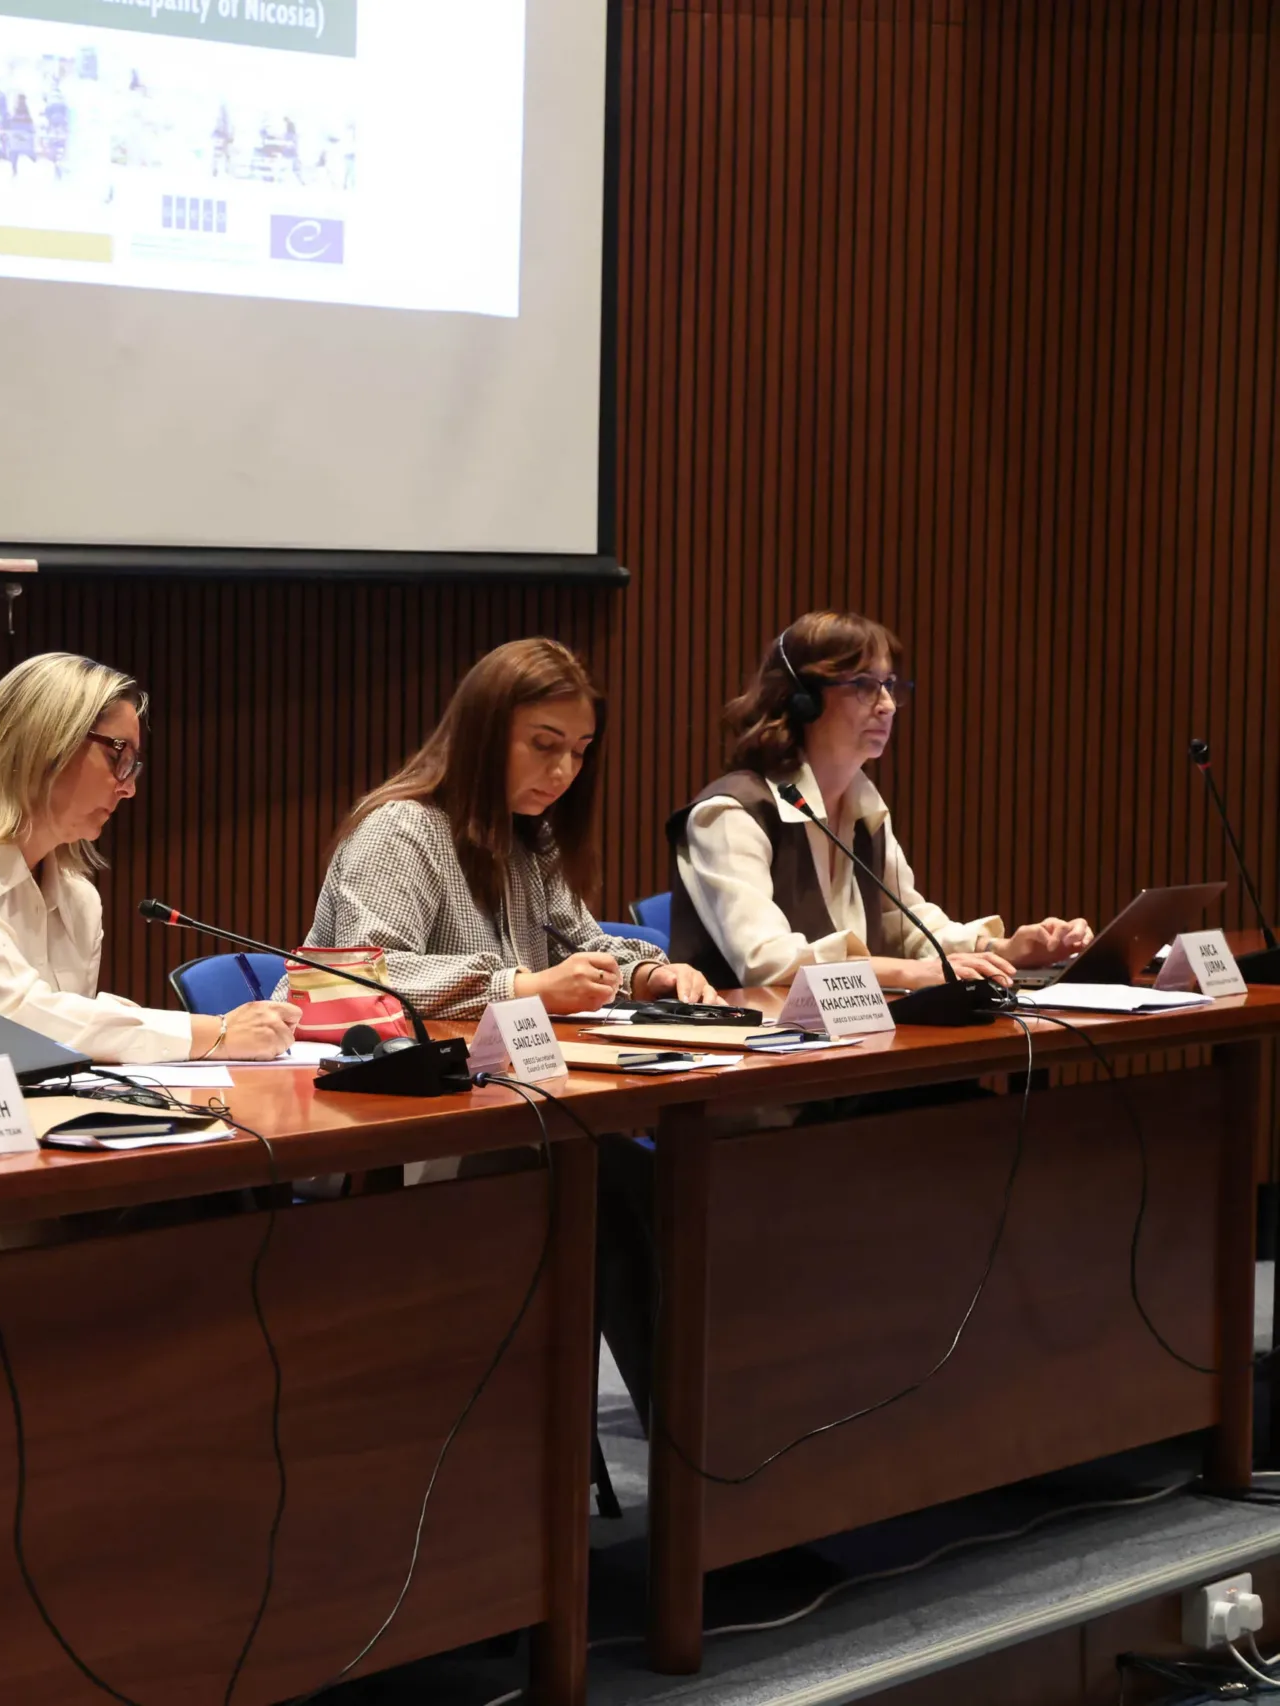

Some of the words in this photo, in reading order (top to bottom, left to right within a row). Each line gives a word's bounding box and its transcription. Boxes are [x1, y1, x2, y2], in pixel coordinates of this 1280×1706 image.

[218, 0, 239, 19] of
[244, 0, 325, 39] Nicosia)
[1199, 944, 1218, 957] ANCA
[1204, 960, 1227, 977] JURMA
[823, 975, 866, 992] TATEVIK
[820, 993, 883, 1011] KHACHATRYAN
[513, 1017, 537, 1032] LAURA
[512, 1032, 551, 1050] SANZ-LEVIA
